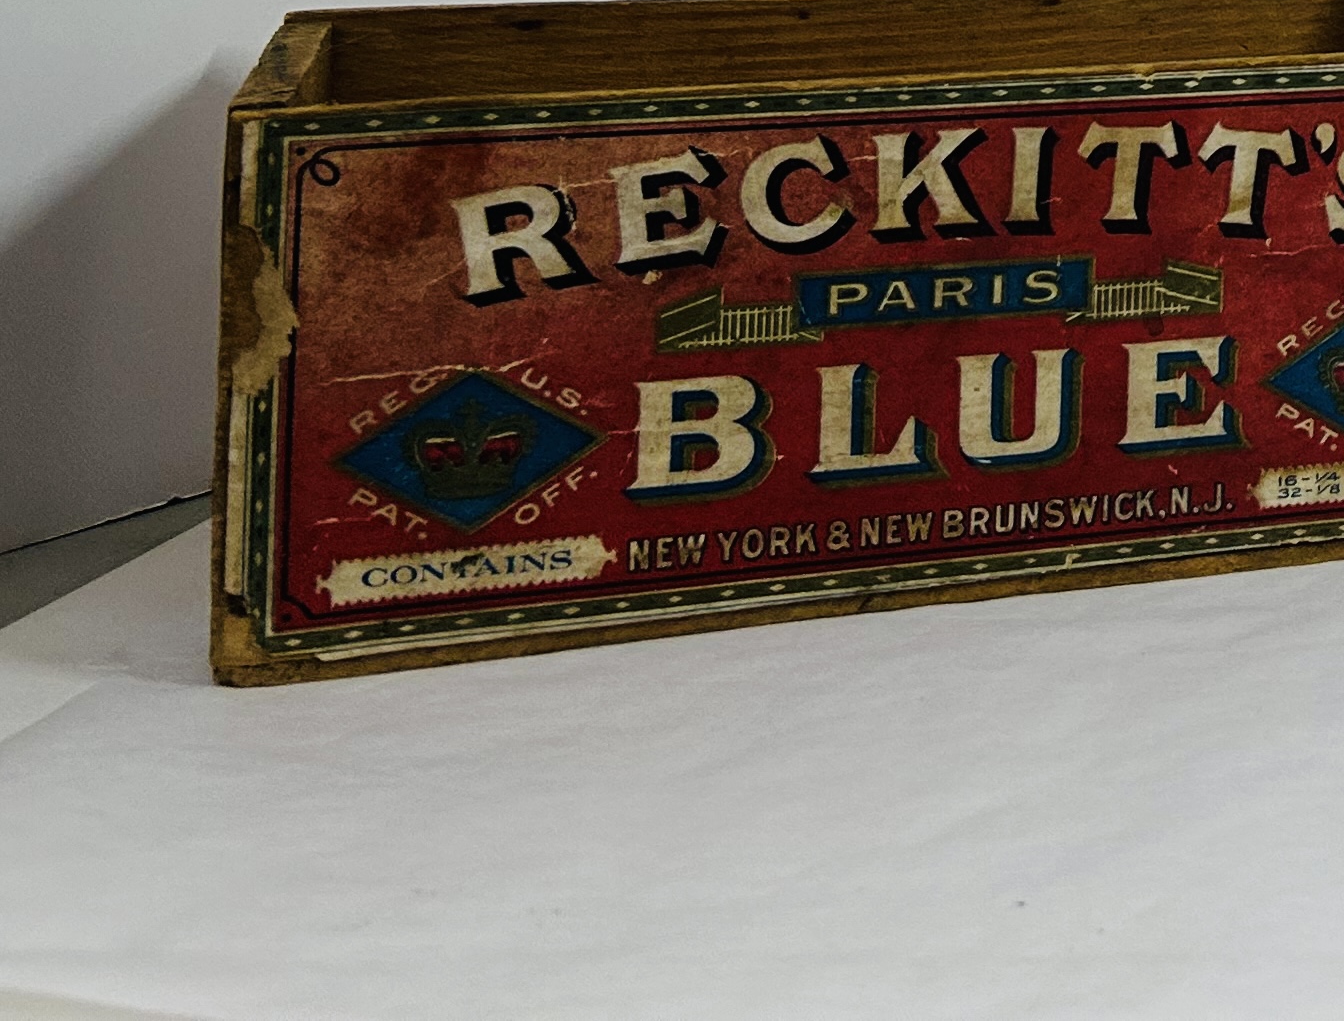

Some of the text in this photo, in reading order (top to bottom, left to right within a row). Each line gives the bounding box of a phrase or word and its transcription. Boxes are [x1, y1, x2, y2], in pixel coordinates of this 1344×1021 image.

[827, 269, 1060, 316] PARIS
[520, 367, 588, 416] U.S.
[624, 336, 1251, 501] BLUE
[1275, 402, 1339, 452] PAT.
[348, 465, 599, 540] PAT. OFF.
[628, 533, 705, 572] NEW
[718, 521, 816, 562] YORK
[826, 519, 851, 553] &
[860, 510, 934, 549] NEW
[361, 549, 574, 588] CONTAINS
